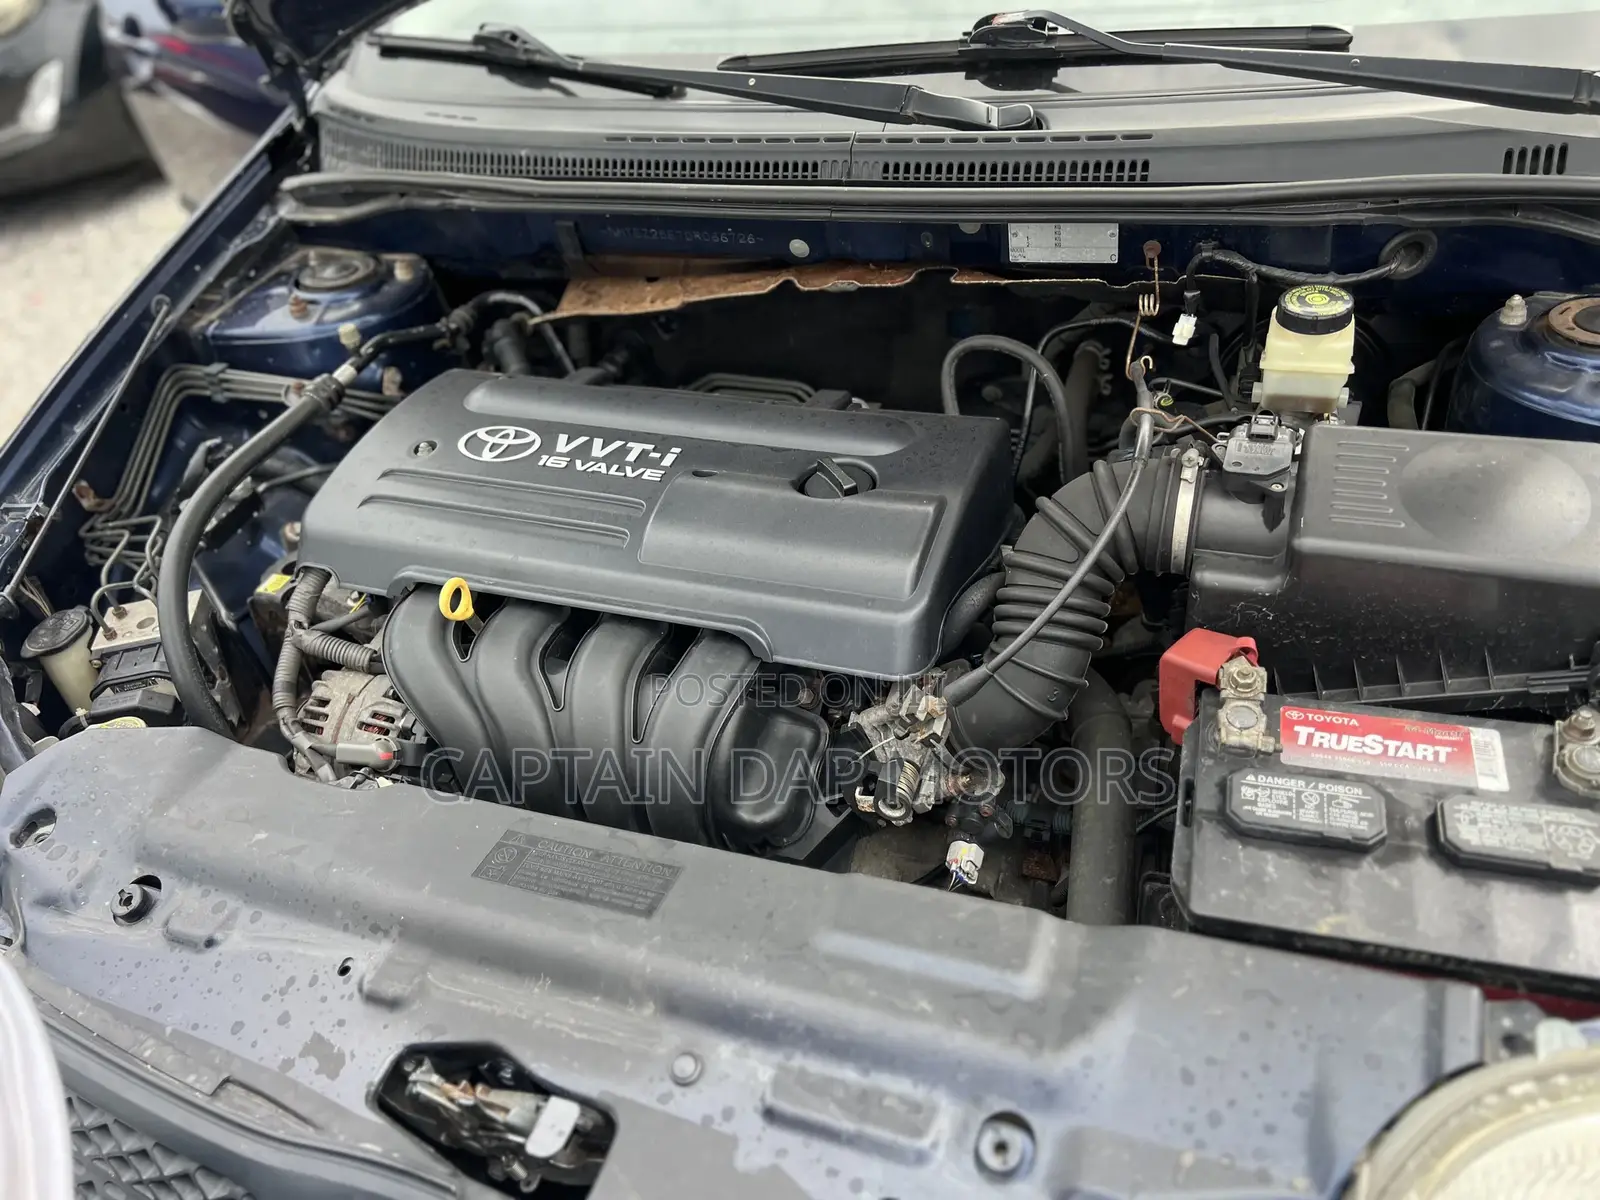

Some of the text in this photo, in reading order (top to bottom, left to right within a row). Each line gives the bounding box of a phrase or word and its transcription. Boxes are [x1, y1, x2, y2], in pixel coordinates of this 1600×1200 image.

[556, 433, 683, 468] VVT-i
[537, 454, 667, 482] 16 VALVE
[1306, 713, 1360, 728] TOYOTA
[1293, 725, 1452, 764] TRUESTART
[1258, 774, 1306, 789] DANGER
[1318, 782, 1363, 796] POISON
[538, 839, 594, 859] CAUTION
[600, 853, 673, 877] ATTENTION
